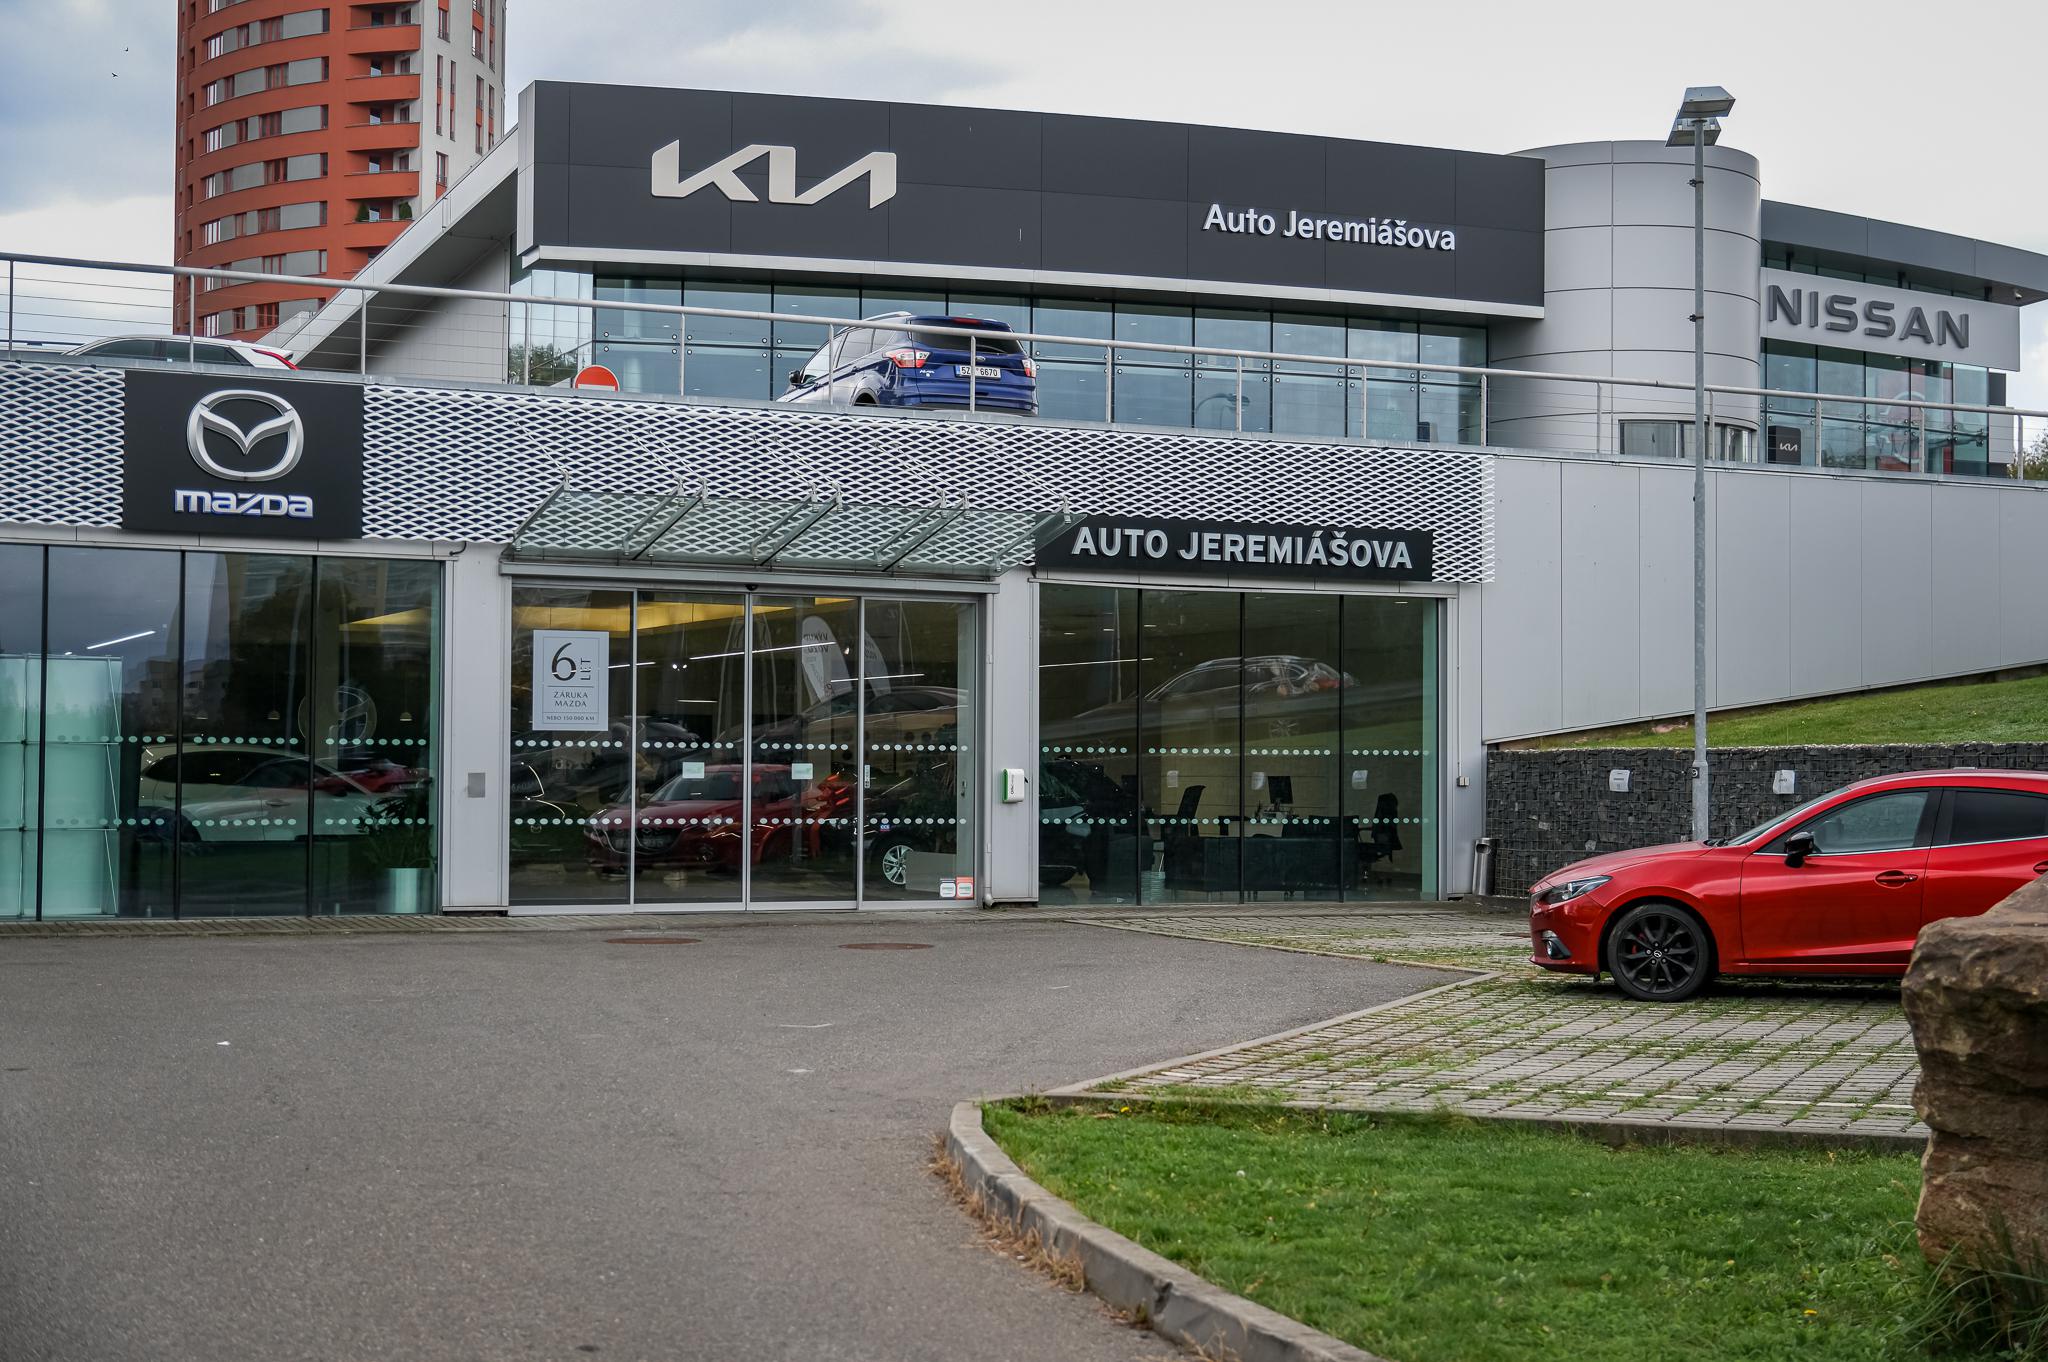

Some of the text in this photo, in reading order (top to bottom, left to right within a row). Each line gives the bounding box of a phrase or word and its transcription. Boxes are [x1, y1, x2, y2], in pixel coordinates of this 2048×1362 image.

[651, 139, 897, 209] KIA
[1202, 203, 1456, 251] Auto Jeremiášova
[1768, 284, 1970, 349] NISSAN
[174, 489, 314, 519] mazda
[1071, 526, 1413, 569] AUTO JEREMIÁŠOVA
[551, 642, 577, 682] 6
[580, 657, 591, 680] LET
[554, 700, 587, 708] MAZDA
